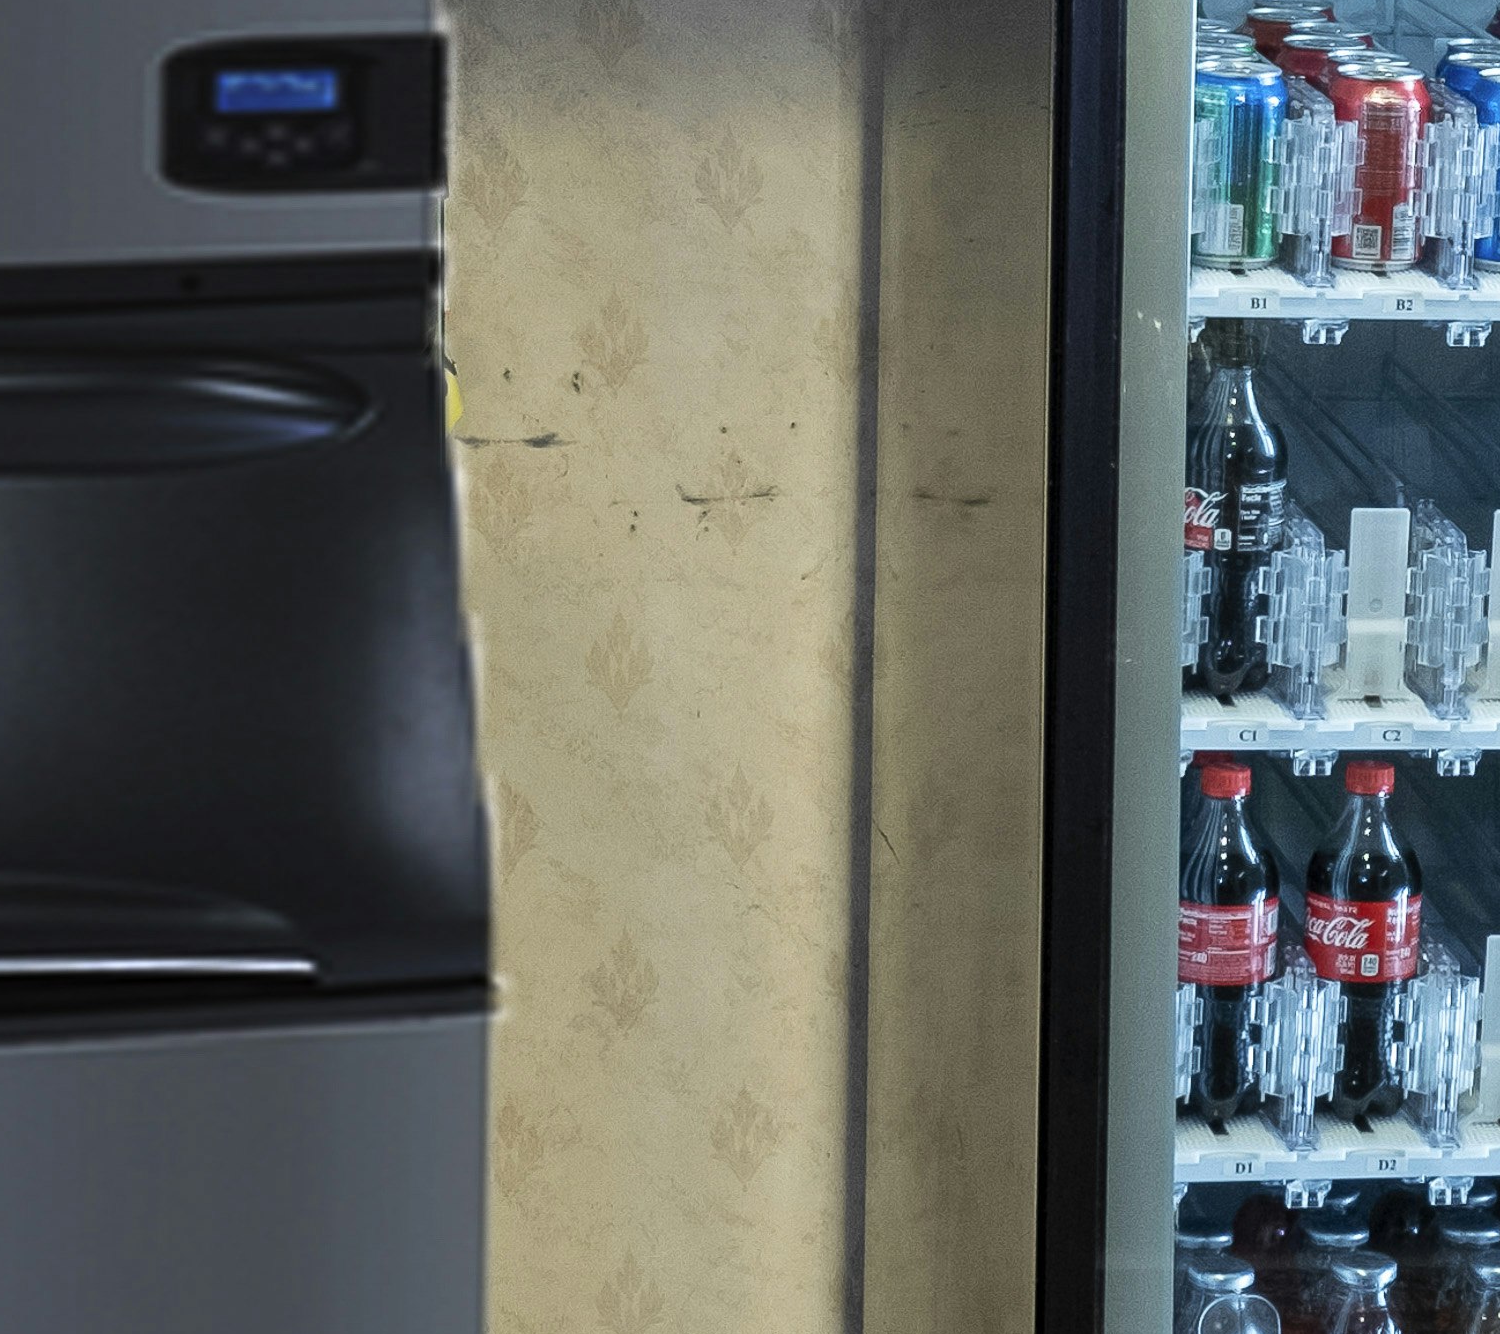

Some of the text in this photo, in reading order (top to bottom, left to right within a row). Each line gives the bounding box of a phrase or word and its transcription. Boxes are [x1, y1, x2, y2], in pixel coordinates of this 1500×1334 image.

[1250, 297, 1268, 310] B1
[1395, 298, 1414, 311] B2
[1239, 729, 1257, 742] C1
[1382, 729, 1401, 742] C2
[1308, 916, 1376, 949] ca-Cola
[1235, 1161, 1254, 1174] D1
[1378, 1158, 1397, 1172] D2
